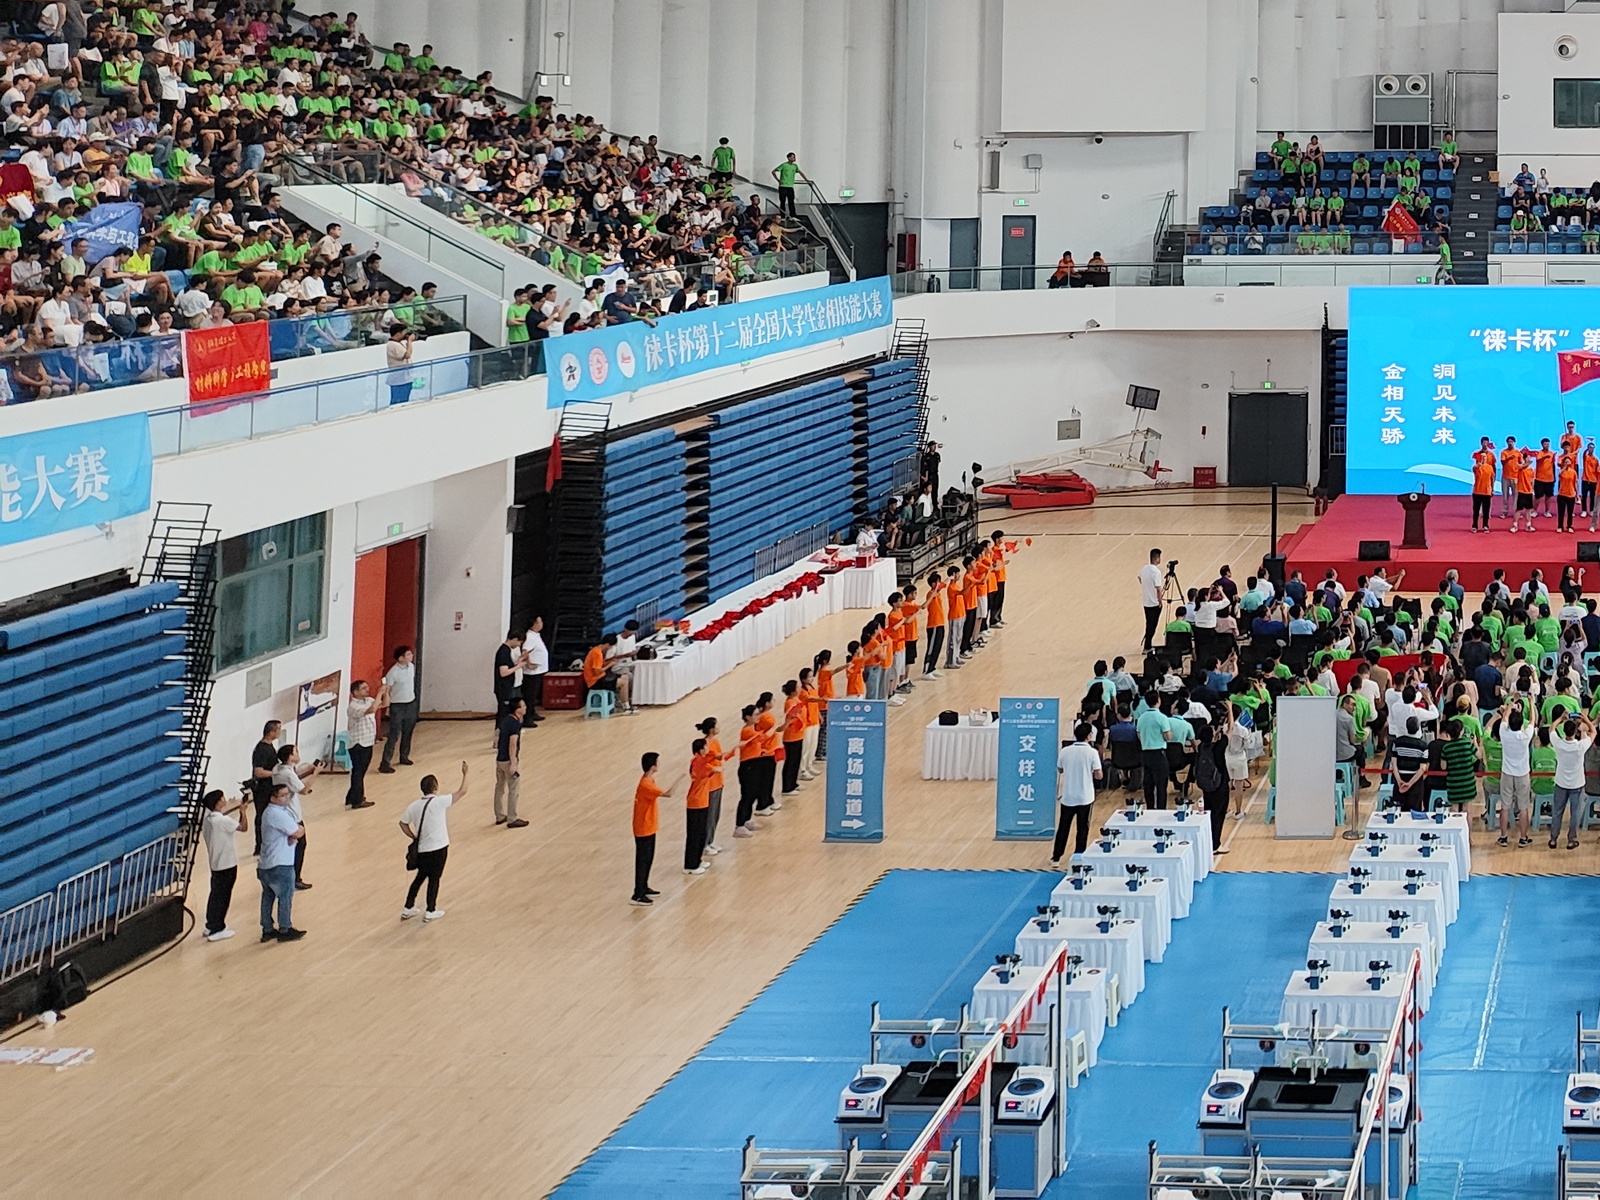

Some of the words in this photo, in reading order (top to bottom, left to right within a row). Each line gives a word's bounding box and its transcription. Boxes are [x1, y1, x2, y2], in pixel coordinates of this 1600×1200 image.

[643, 289, 883, 373] 徕卡杯第十二届全国大学生金相技能大赛
[1381, 363, 1406, 445] 金相天骄
[1431, 363, 1457, 445] 洞见未来
[846, 737, 865, 816] 离场通道
[1017, 735, 1037, 825] 交样处二
